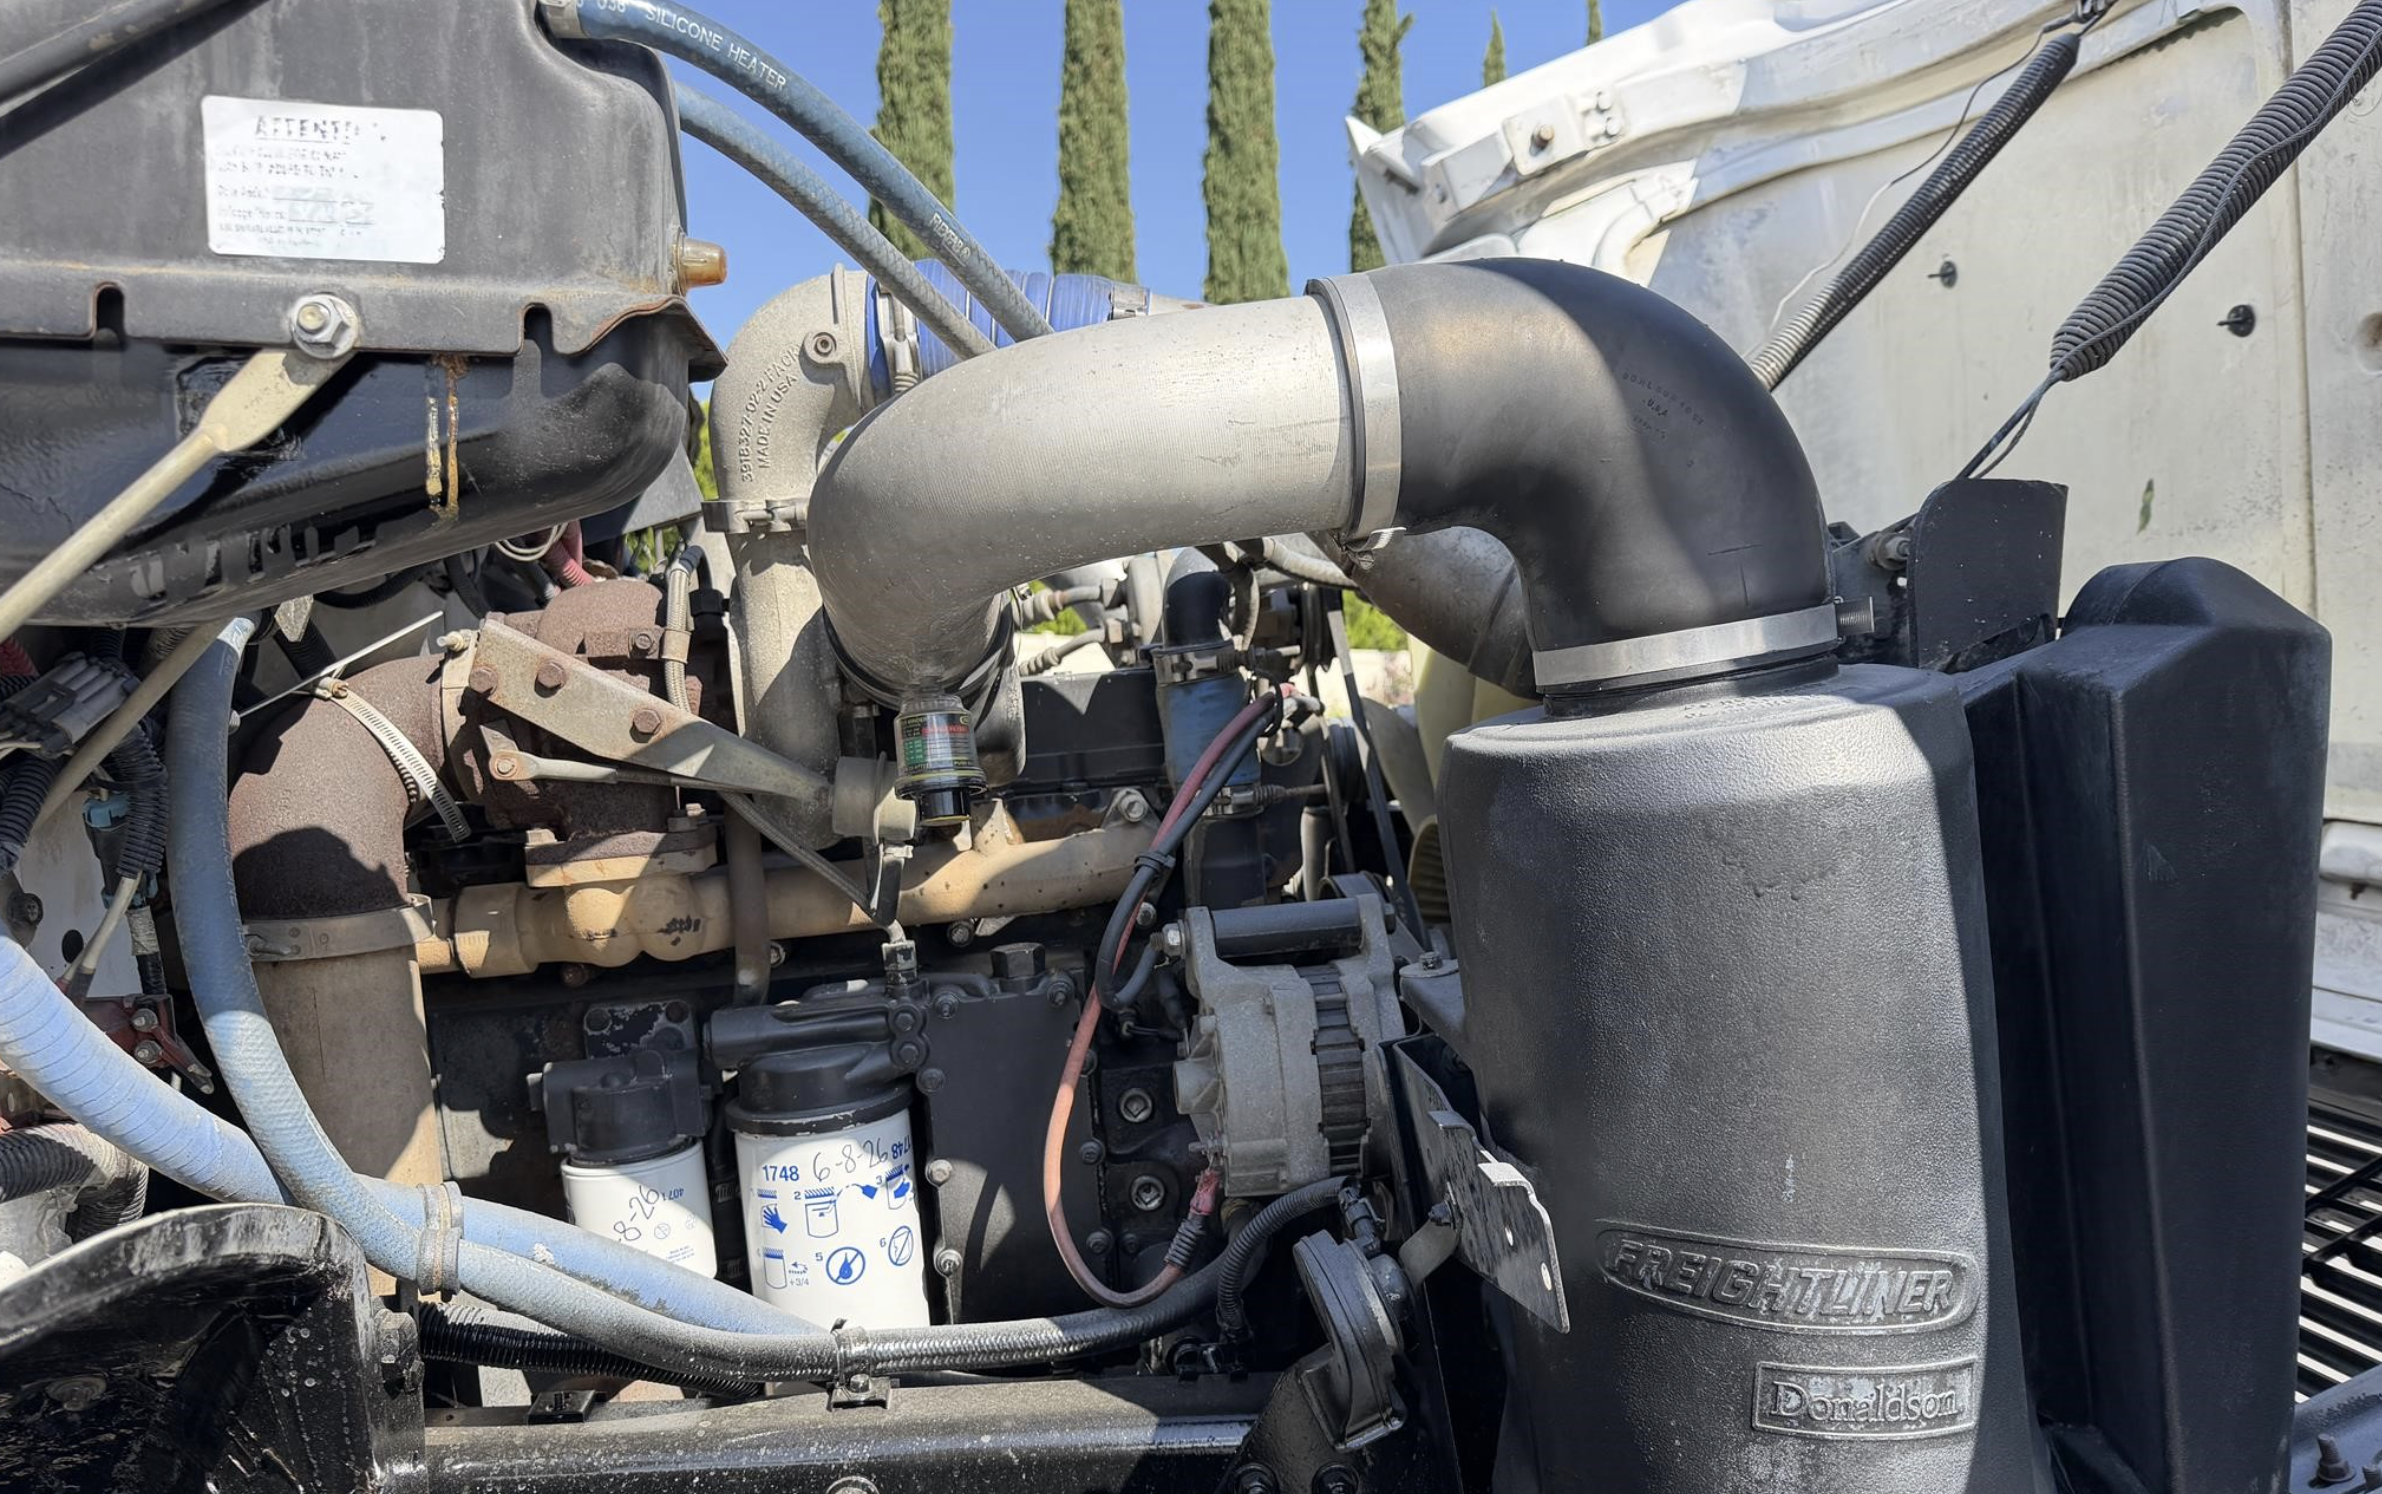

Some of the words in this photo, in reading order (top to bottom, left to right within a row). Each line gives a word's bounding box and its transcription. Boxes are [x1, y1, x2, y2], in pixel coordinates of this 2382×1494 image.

[645, 6, 723, 52] SILICONE
[727, 43, 787, 90] HEATER
[255, 114, 387, 141] ATTENTI
[770, 374, 798, 403] USA
[762, 402, 778, 423] IN
[756, 424, 771, 469] MADE
[762, 1165, 800, 1182] 1748
[812, 1137, 888, 1183] 6-8-26
[815, 1252, 823, 1262] 5
[1607, 1239, 1955, 1317] FREIGHTLINER
[1770, 1380, 1961, 1425] Donaldson
